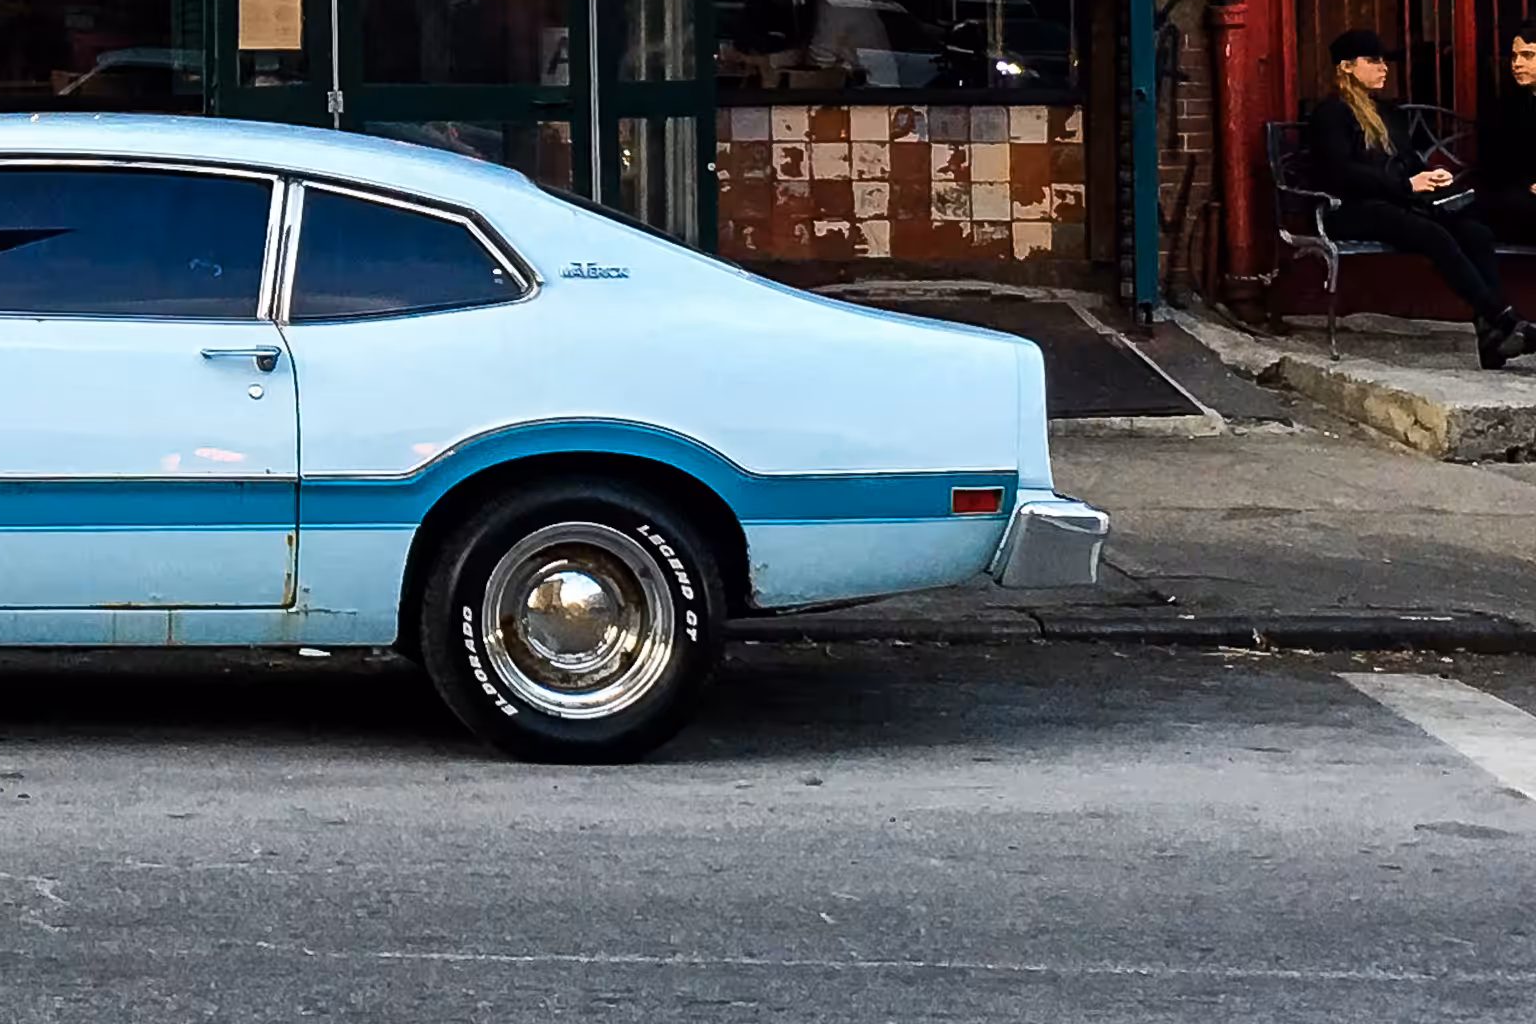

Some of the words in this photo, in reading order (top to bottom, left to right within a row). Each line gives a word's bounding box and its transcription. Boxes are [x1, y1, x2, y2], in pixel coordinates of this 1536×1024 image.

[636, 524, 695, 600] LEGEND
[686, 609, 698, 642] GT
[462, 605, 519, 717] ELDORADO
